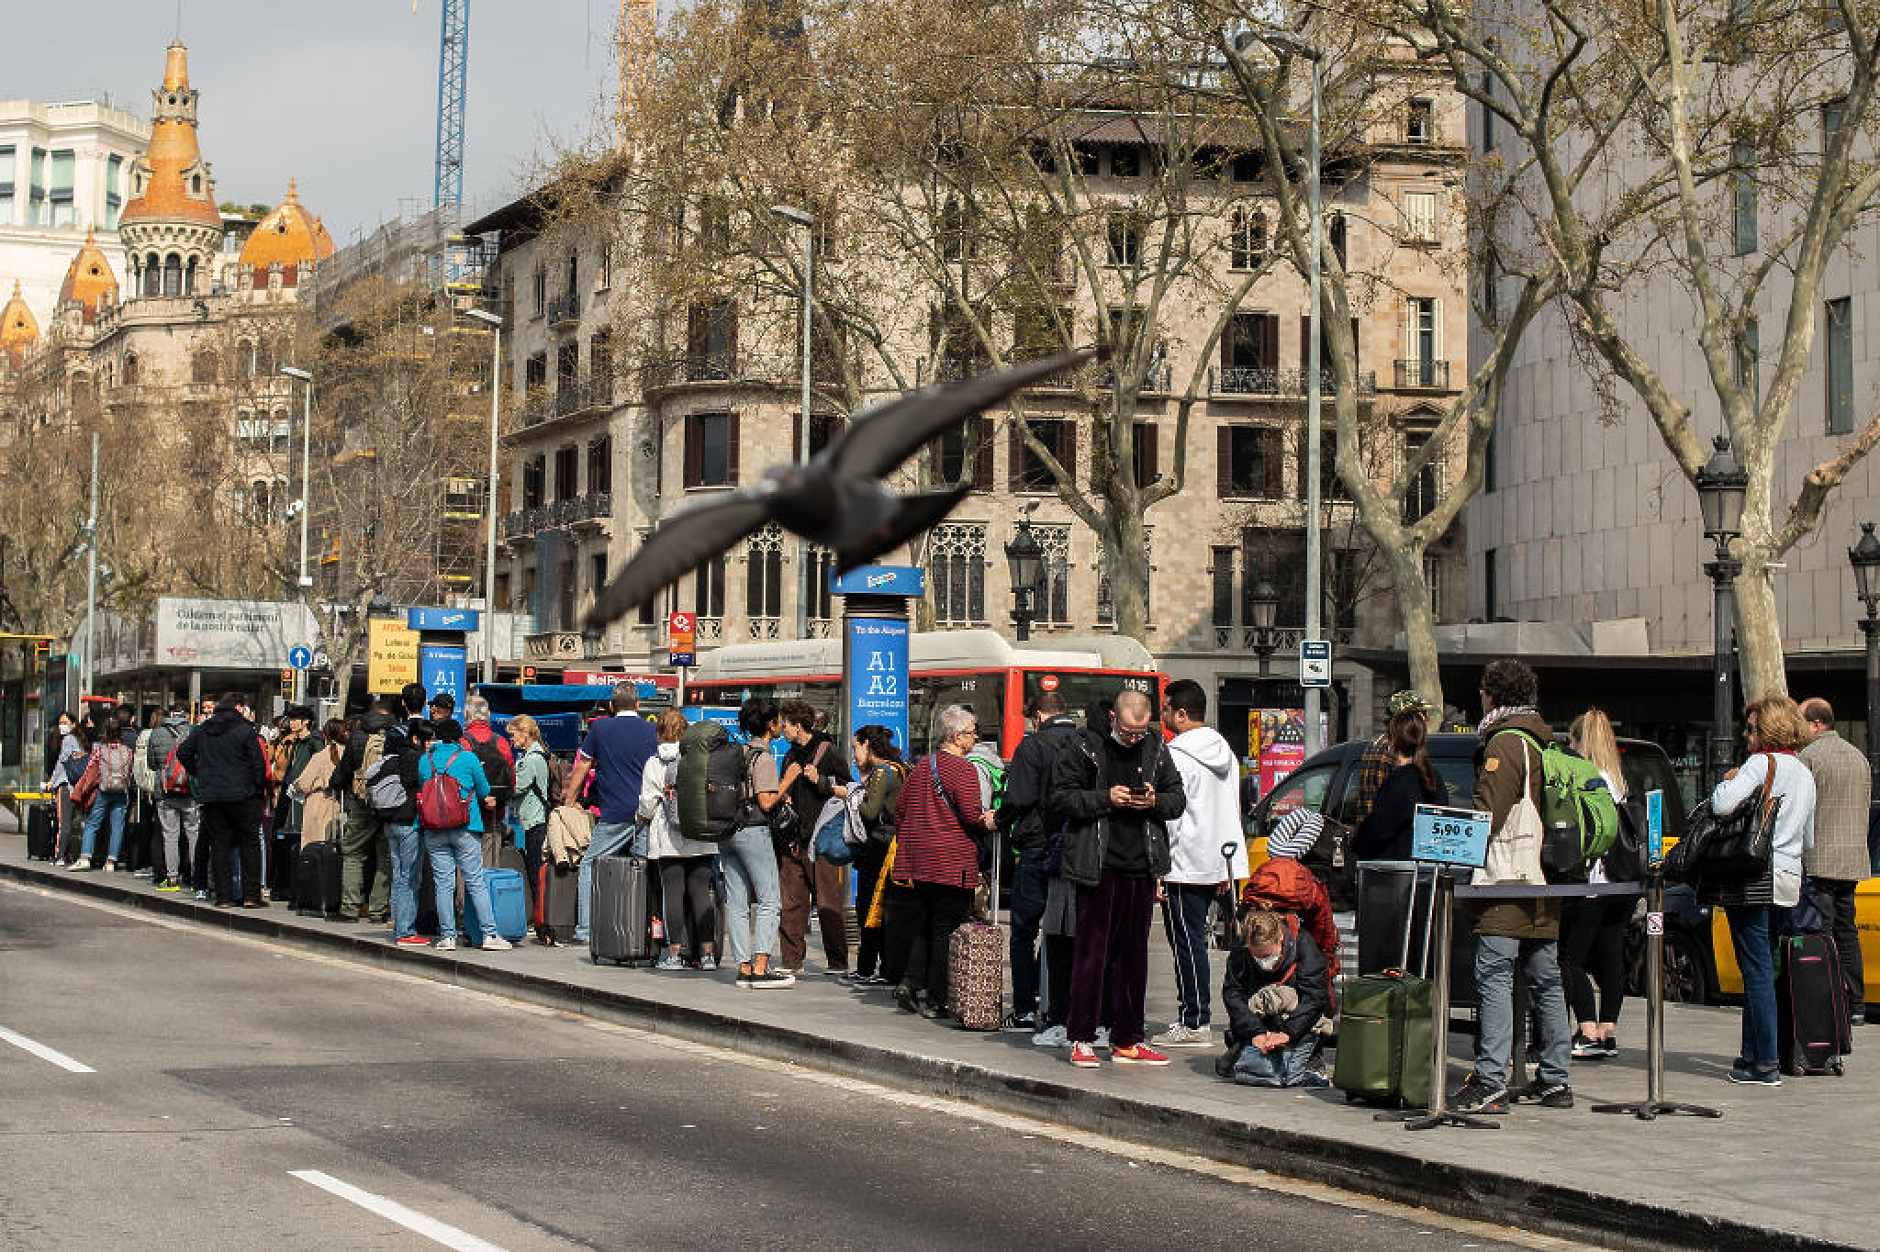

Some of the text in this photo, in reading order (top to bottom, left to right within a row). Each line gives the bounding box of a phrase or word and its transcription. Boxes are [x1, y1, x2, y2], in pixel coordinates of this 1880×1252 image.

[866, 651, 895, 671] A1
[433, 670, 456, 686] A1
[866, 675, 897, 695] A2
[857, 698, 905, 708] Barcelona
[1431, 822, 1461, 836] 5,90
